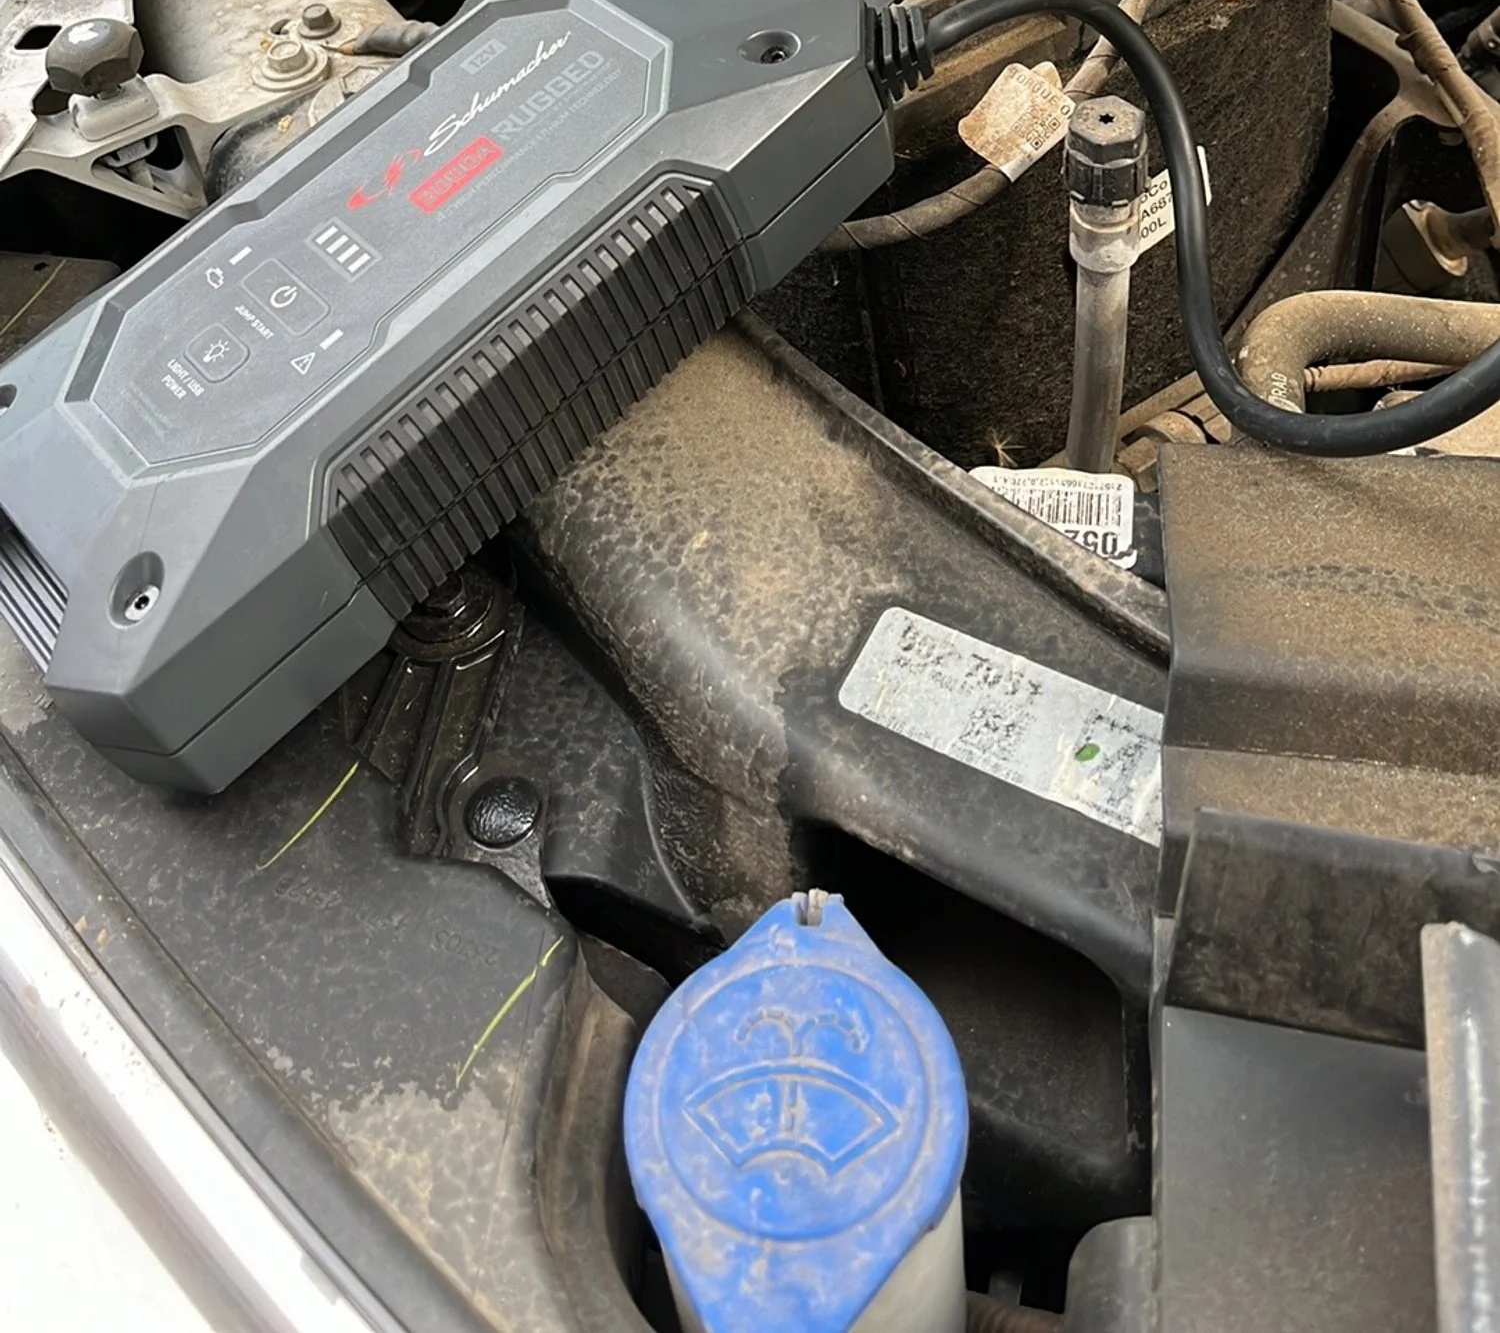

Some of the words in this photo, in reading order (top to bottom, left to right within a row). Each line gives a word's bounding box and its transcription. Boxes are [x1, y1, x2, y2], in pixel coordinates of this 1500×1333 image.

[469, 43, 494, 68] 12V
[424, 31, 572, 156] Schumacher
[490, 50, 606, 140] RUGGED
[235, 304, 256, 322] JUMP
[251, 318, 275, 340] START
[167, 358, 189, 379] LIGHT
[161, 374, 187, 399] POWER
